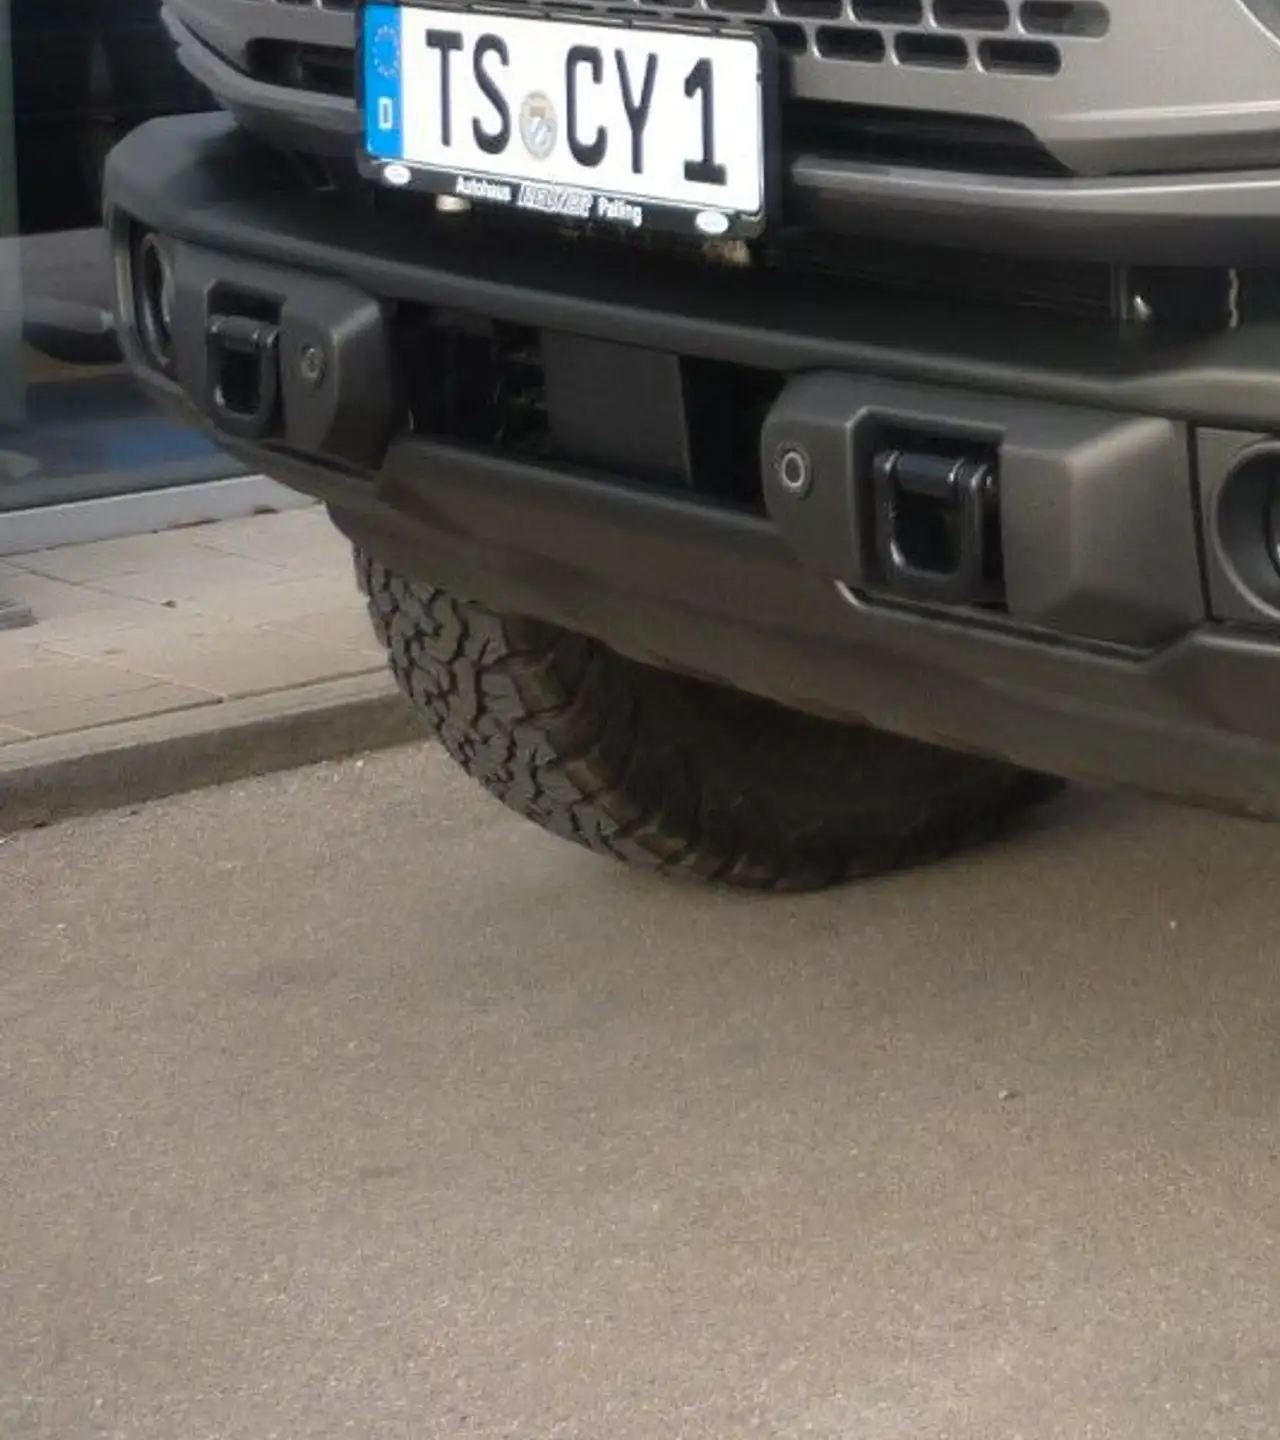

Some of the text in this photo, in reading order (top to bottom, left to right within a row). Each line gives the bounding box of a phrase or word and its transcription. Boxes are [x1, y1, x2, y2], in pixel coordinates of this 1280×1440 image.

[378, 96, 393, 129] D
[425, 29, 727, 185] TS CY 1
[455, 175, 512, 202] Autohaus
[598, 196, 643, 227] Palling
